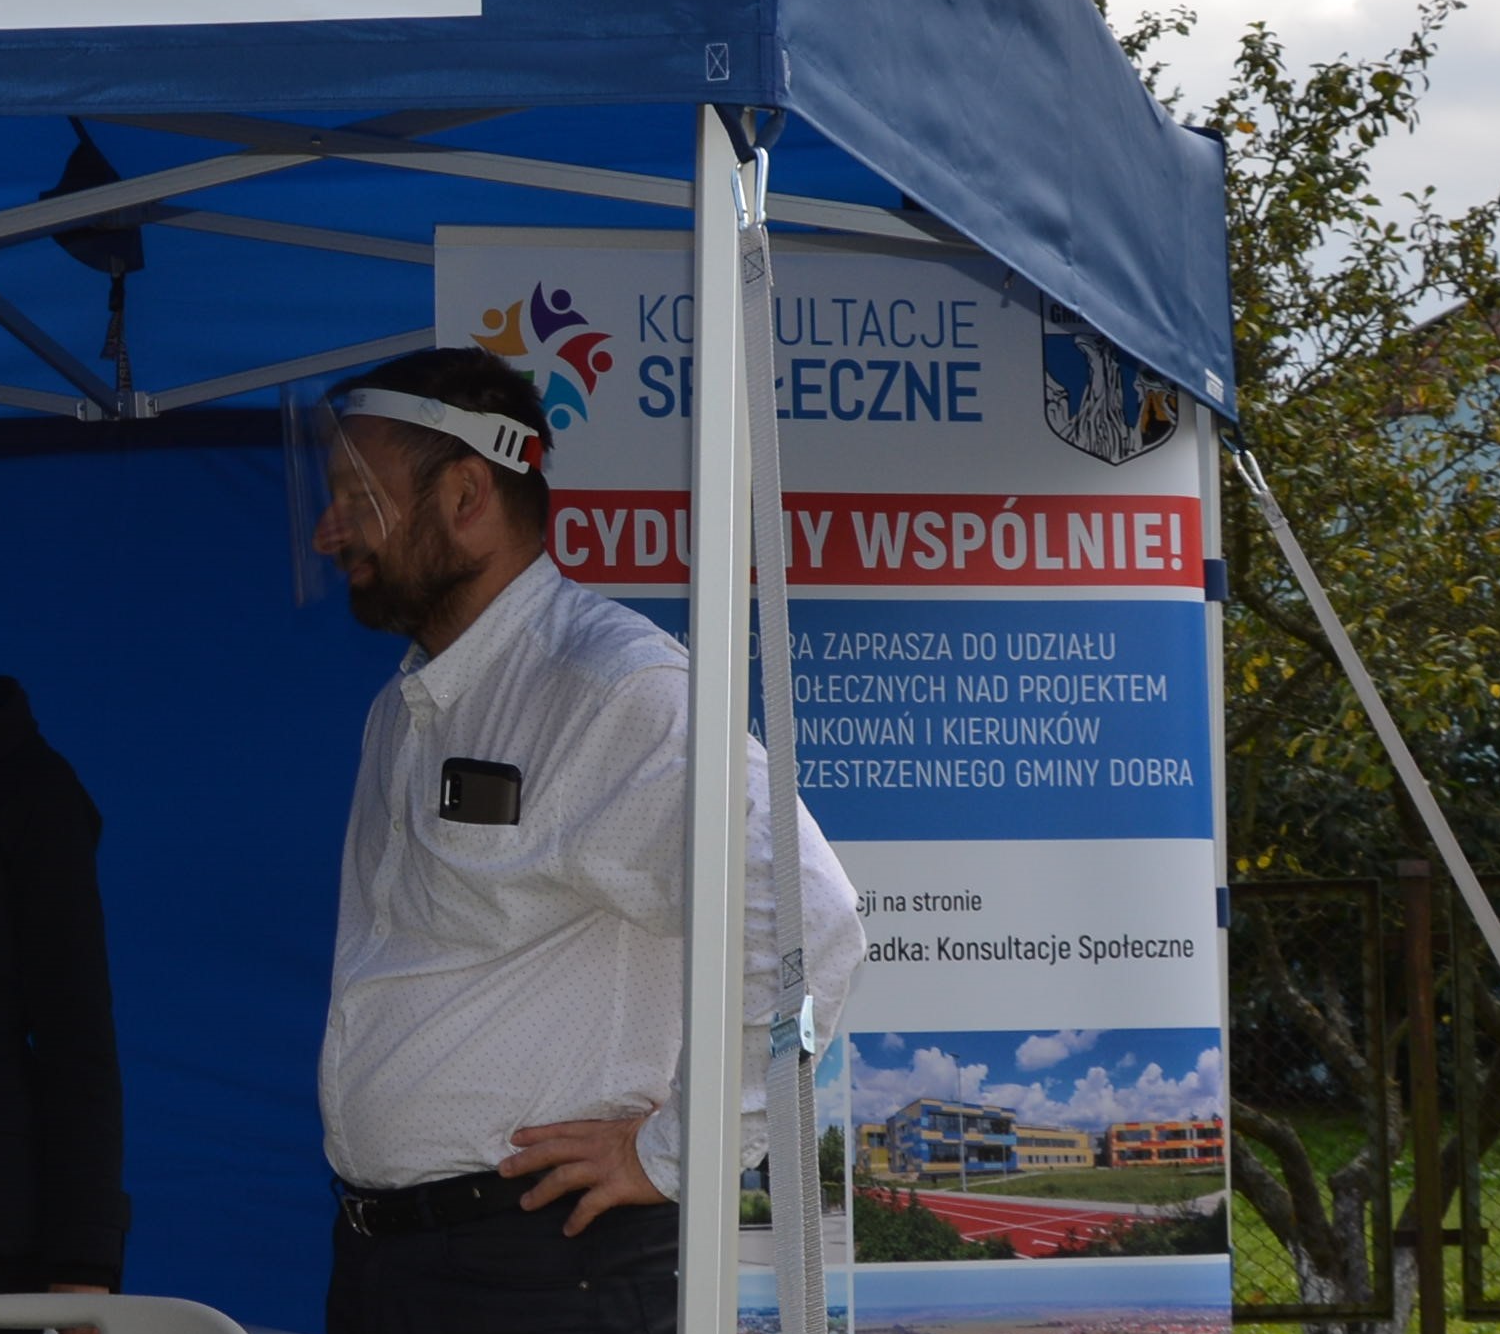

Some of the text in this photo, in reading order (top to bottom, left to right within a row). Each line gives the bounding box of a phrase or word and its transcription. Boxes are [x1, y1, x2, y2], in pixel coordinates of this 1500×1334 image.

[640, 294, 979, 349] KOULTACJE
[851, 499, 1184, 571] WSPÓLNIE!
[823, 632, 953, 661] ZAPRASZA
[963, 632, 998, 661] DO
[1007, 632, 1117, 661] UDZIAŁU
[957, 675, 1009, 703] NAD
[1019, 674, 1168, 705] PROJEKTEM
[926, 718, 931, 745] I
[943, 711, 1101, 746] KIERUNKÓW
[1015, 759, 1099, 788] GMINY
[1111, 758, 1194, 787] DOBRA
[884, 895, 906, 912] na
[912, 890, 983, 912] stronie
[937, 935, 1071, 966] Konsultacje
[1079, 933, 1195, 965] Społeczne
